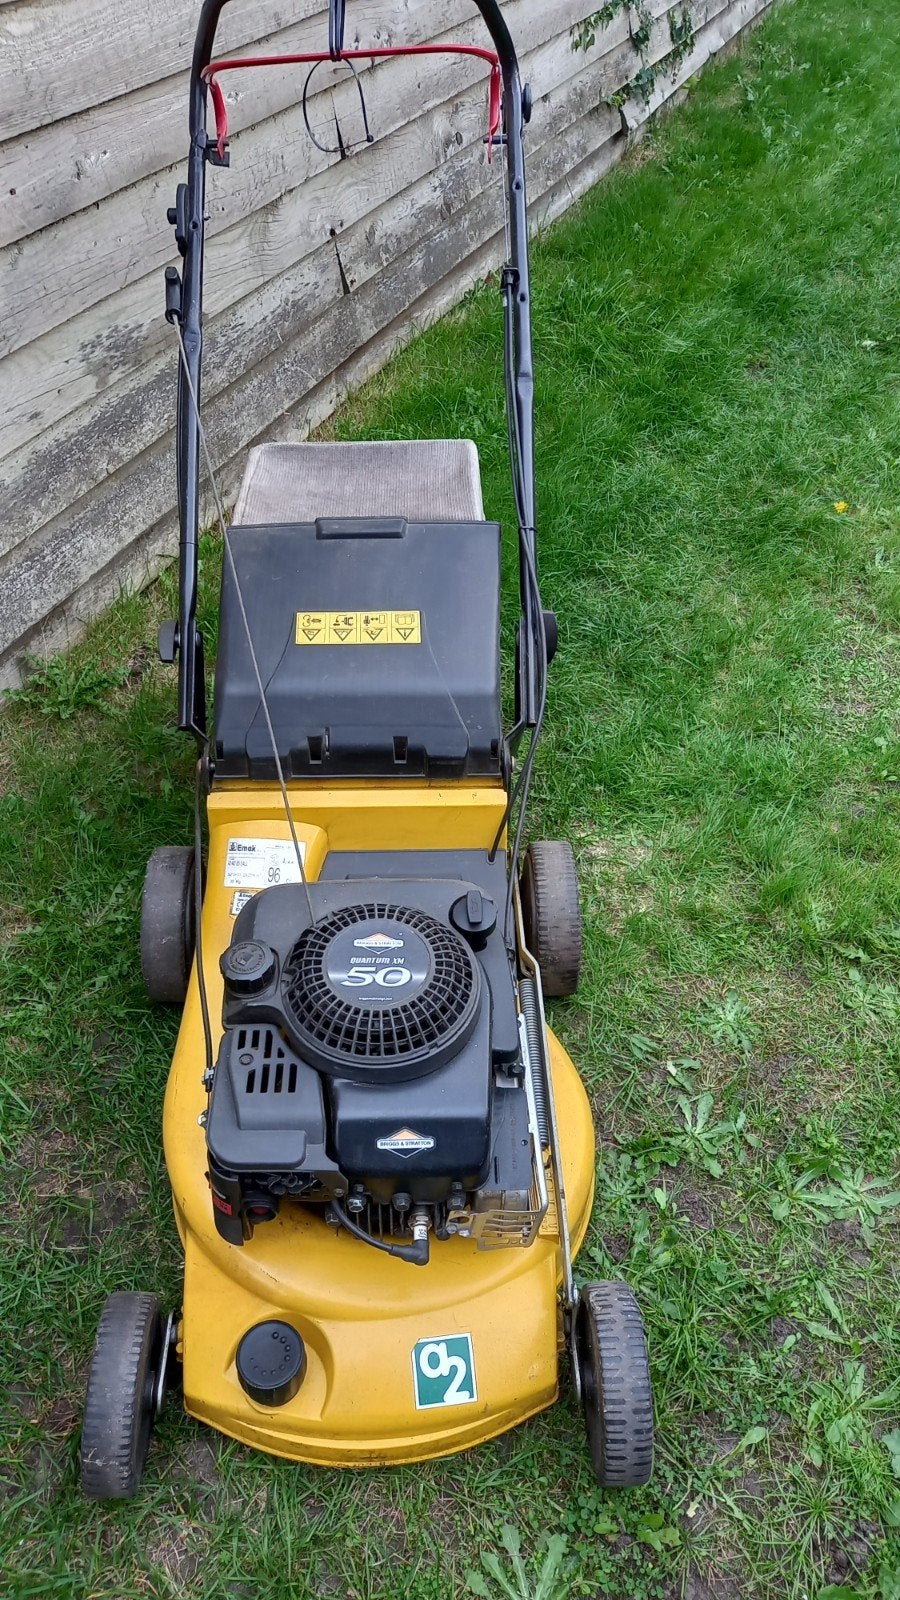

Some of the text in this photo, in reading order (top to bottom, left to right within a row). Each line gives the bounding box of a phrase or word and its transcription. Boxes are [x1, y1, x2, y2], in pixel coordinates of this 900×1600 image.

[237, 844, 256, 852] Emak
[267, 867, 280, 883] 96
[340, 966, 412, 987] 50
